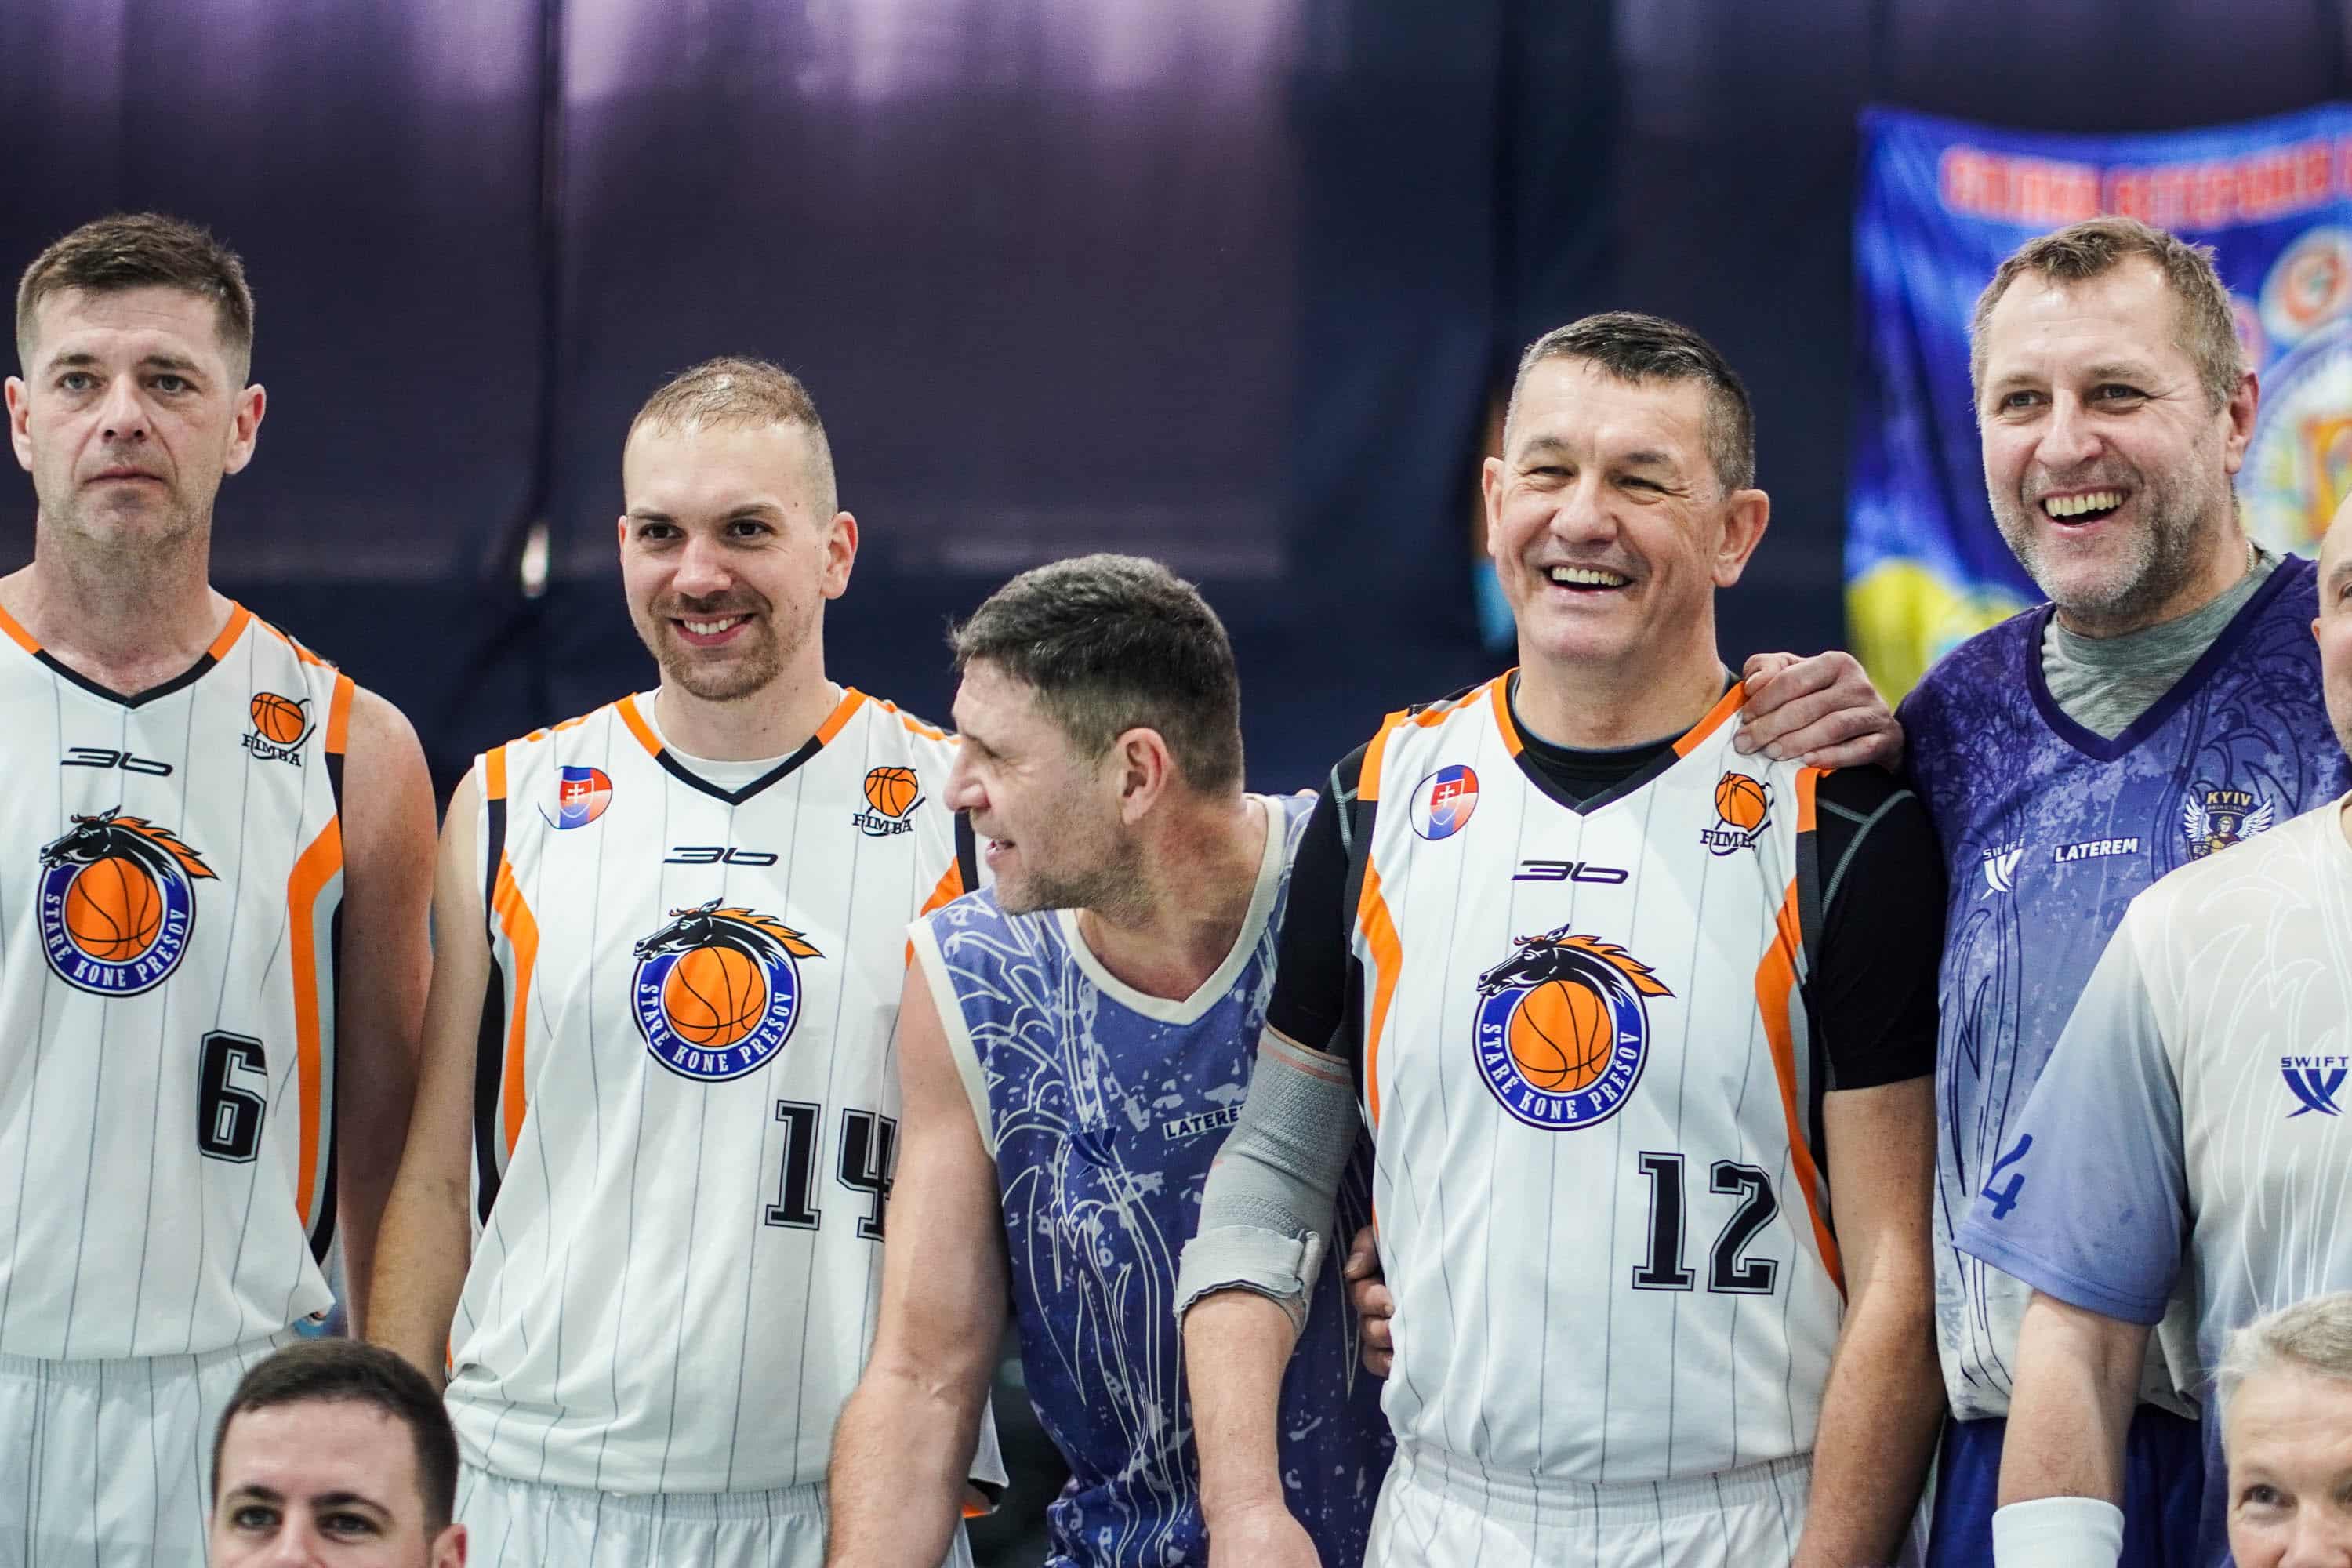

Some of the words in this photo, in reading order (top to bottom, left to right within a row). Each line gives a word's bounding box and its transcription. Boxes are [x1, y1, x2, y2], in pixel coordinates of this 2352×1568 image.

[241, 733, 302, 767] FIMBA
[2207, 791, 2252, 806] KYIV
[851, 813, 914, 834] FIMBA
[1700, 829, 1757, 851] FIMB
[2055, 838, 2139, 862] LATEREM
[74, 960, 126, 987] KONE
[673, 1045, 729, 1073] KONE
[2281, 1056, 2349, 1067] SWIFT
[197, 1029, 268, 1163] 6
[1519, 1091, 1578, 1120] KONE
[1164, 1105, 1244, 1138] LATERE
[765, 1099, 898, 1243] 14
[1632, 1151, 1780, 1295] 12
